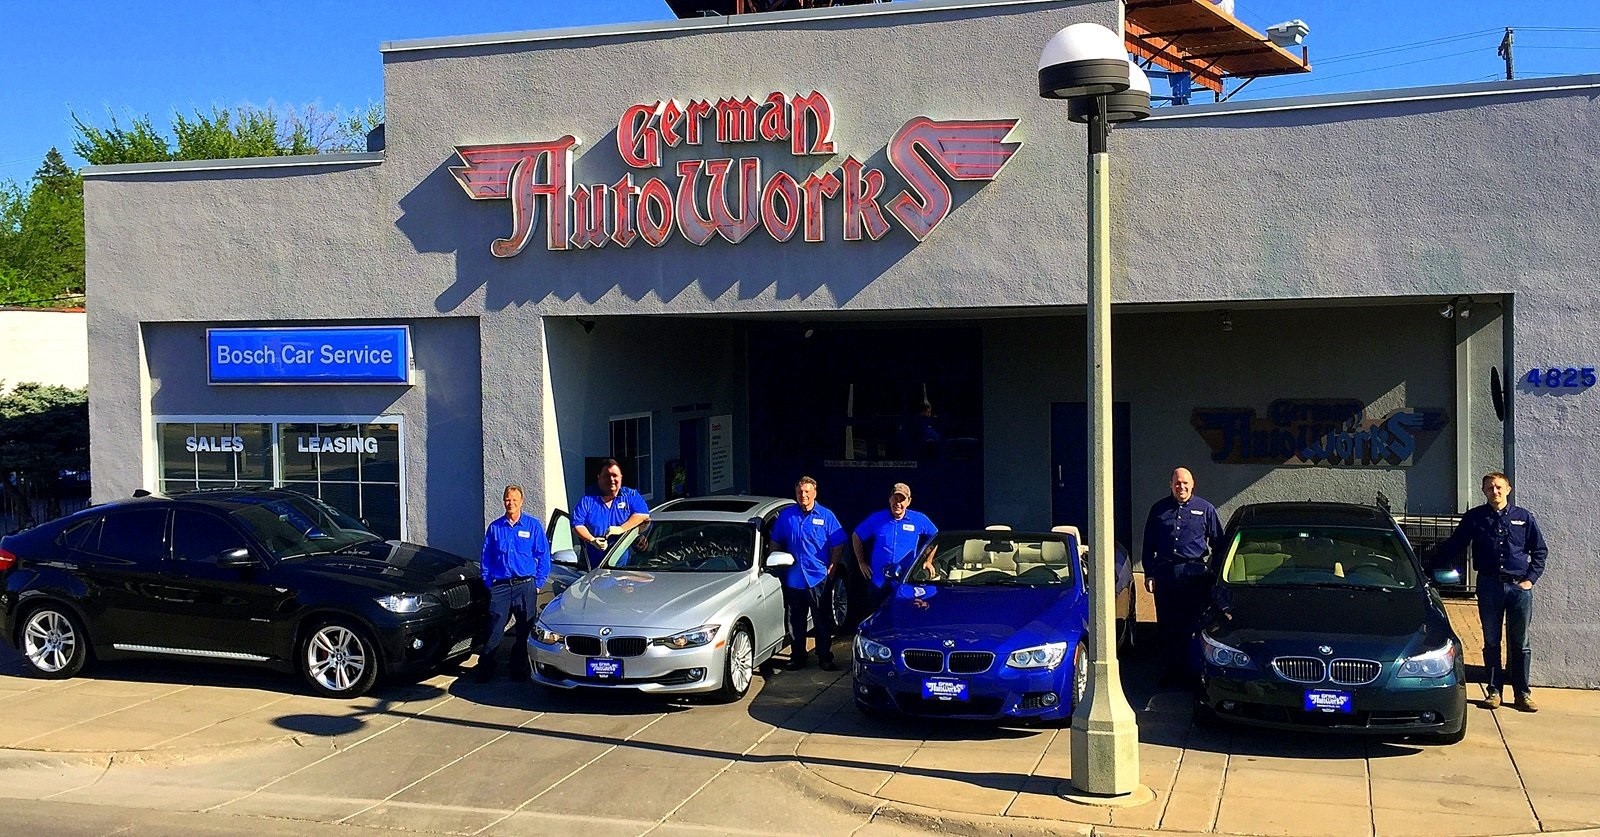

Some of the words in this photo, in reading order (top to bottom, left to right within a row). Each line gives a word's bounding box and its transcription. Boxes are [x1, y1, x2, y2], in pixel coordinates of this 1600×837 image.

[617, 90, 837, 168] German
[217, 345, 275, 364] Bosch
[281, 344, 313, 364] Car
[320, 344, 393, 365] Service
[1527, 367, 1597, 388] 4825
[186, 436, 244, 452] SALES
[298, 437, 378, 454] LEASING
